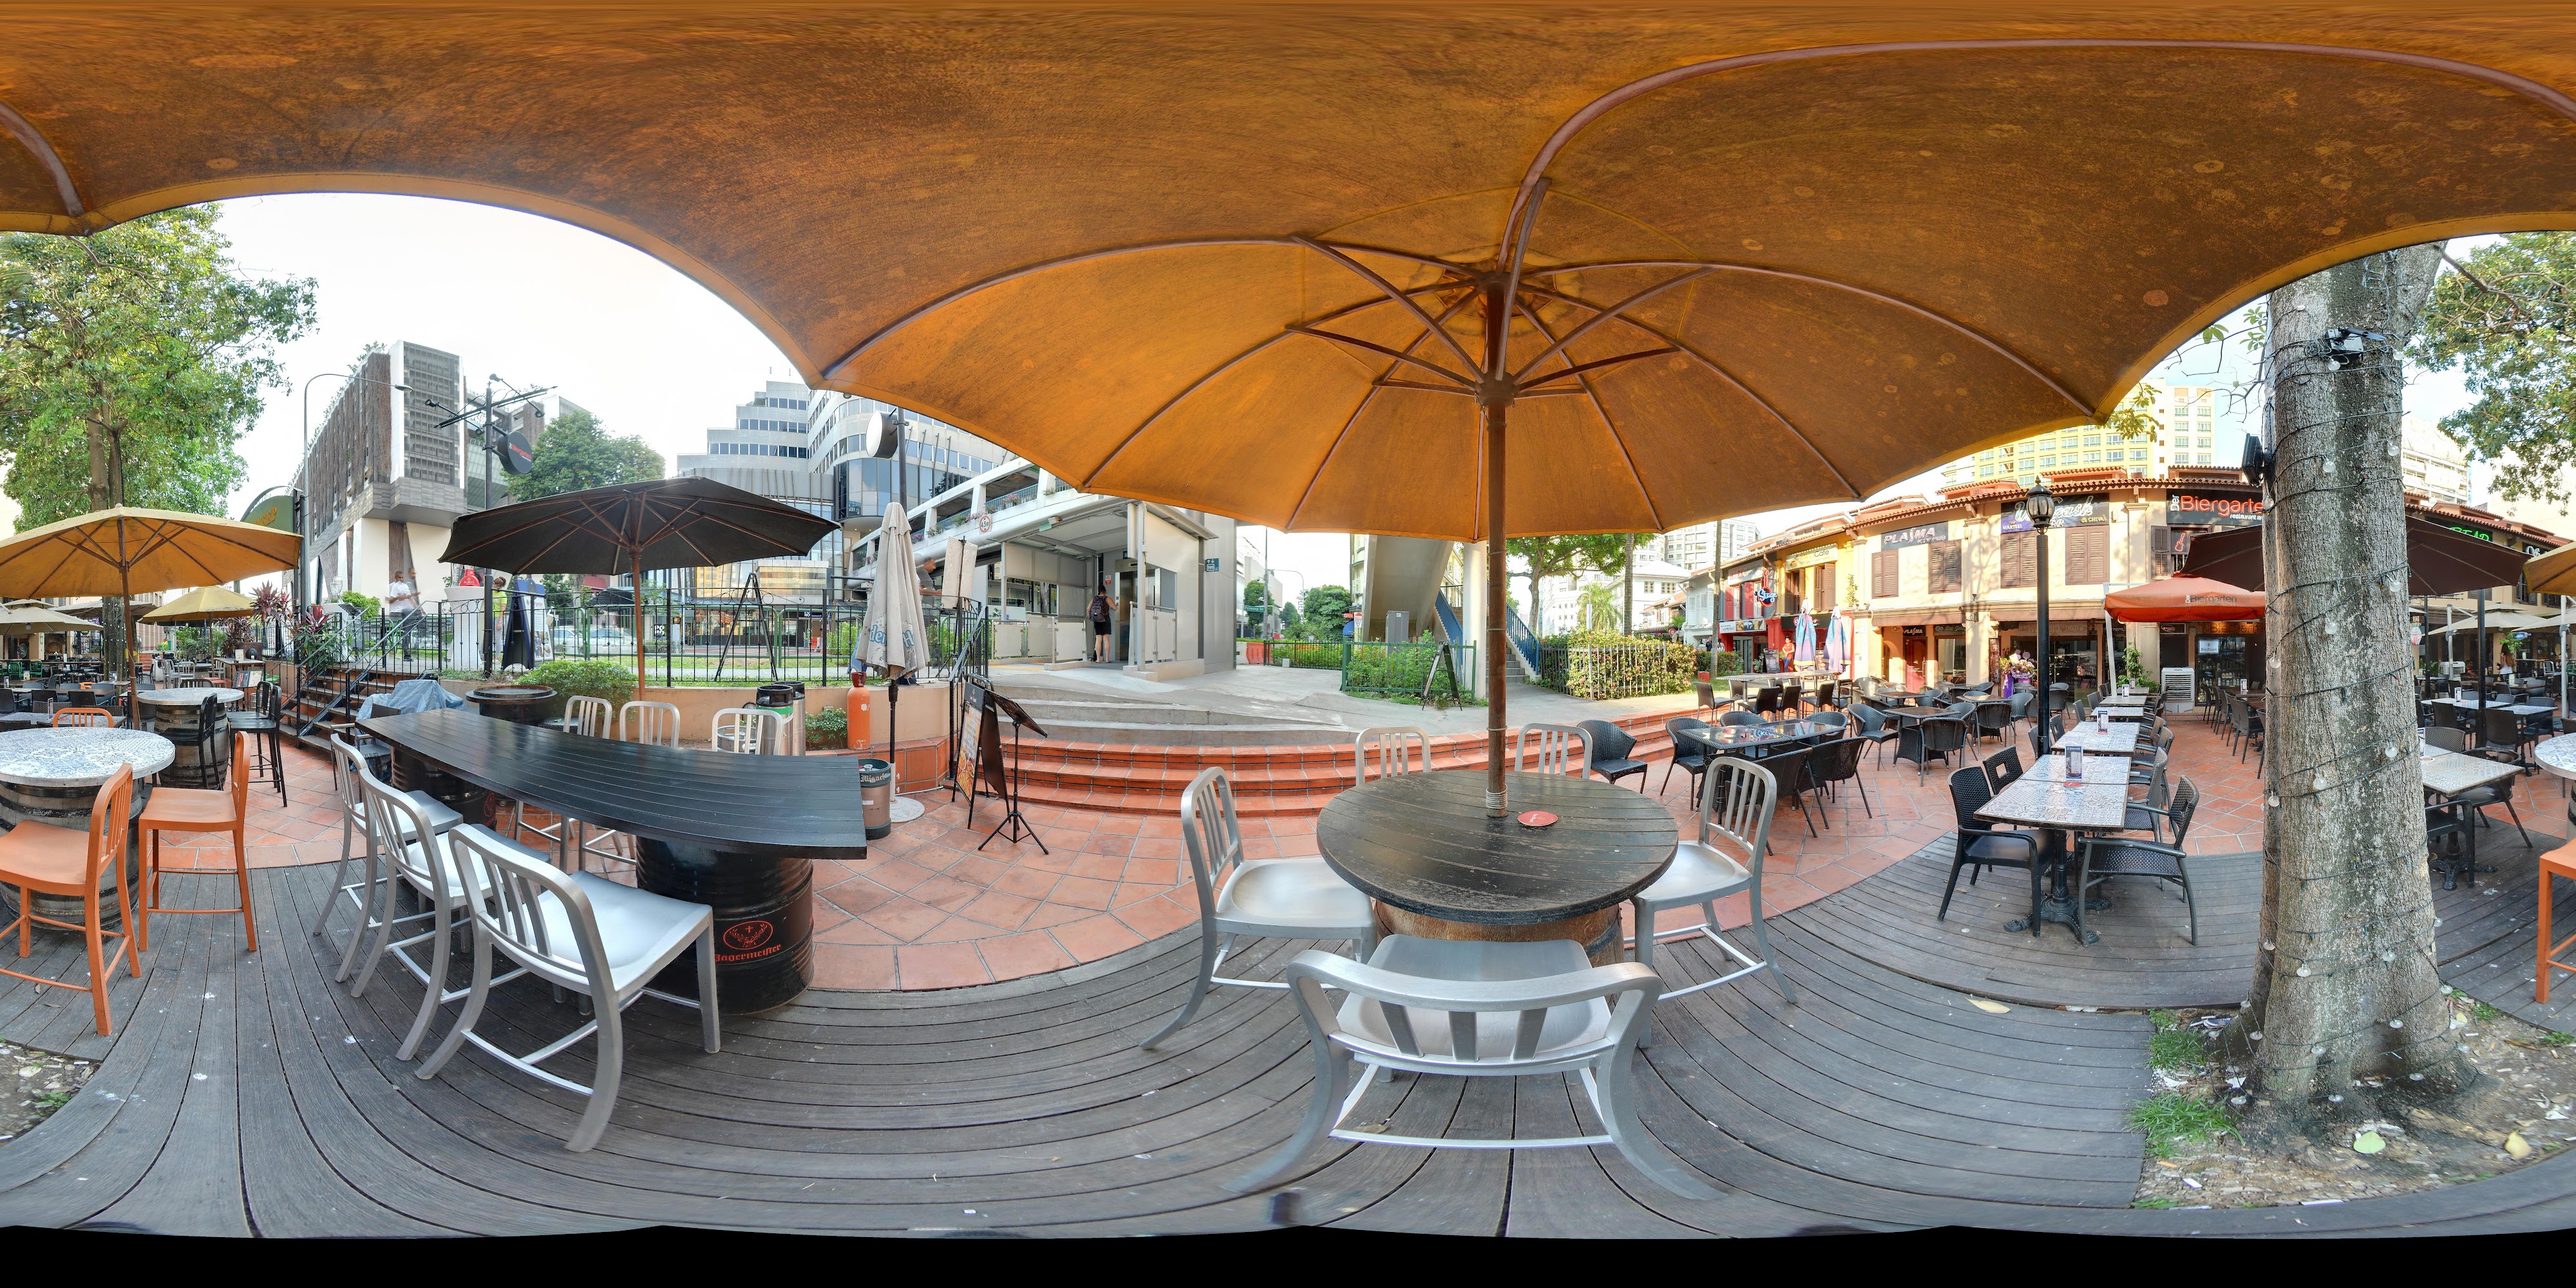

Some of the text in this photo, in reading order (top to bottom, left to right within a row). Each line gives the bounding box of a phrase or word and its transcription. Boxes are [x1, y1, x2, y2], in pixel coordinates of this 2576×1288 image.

[2170, 495, 2264, 517] Der Biergarte
[1884, 527, 1935, 545] PLASMA
[1757, 589, 1778, 603] Stage
[2190, 595, 2237, 604] Biergarten
[860, 773, 885, 783] Miguel
